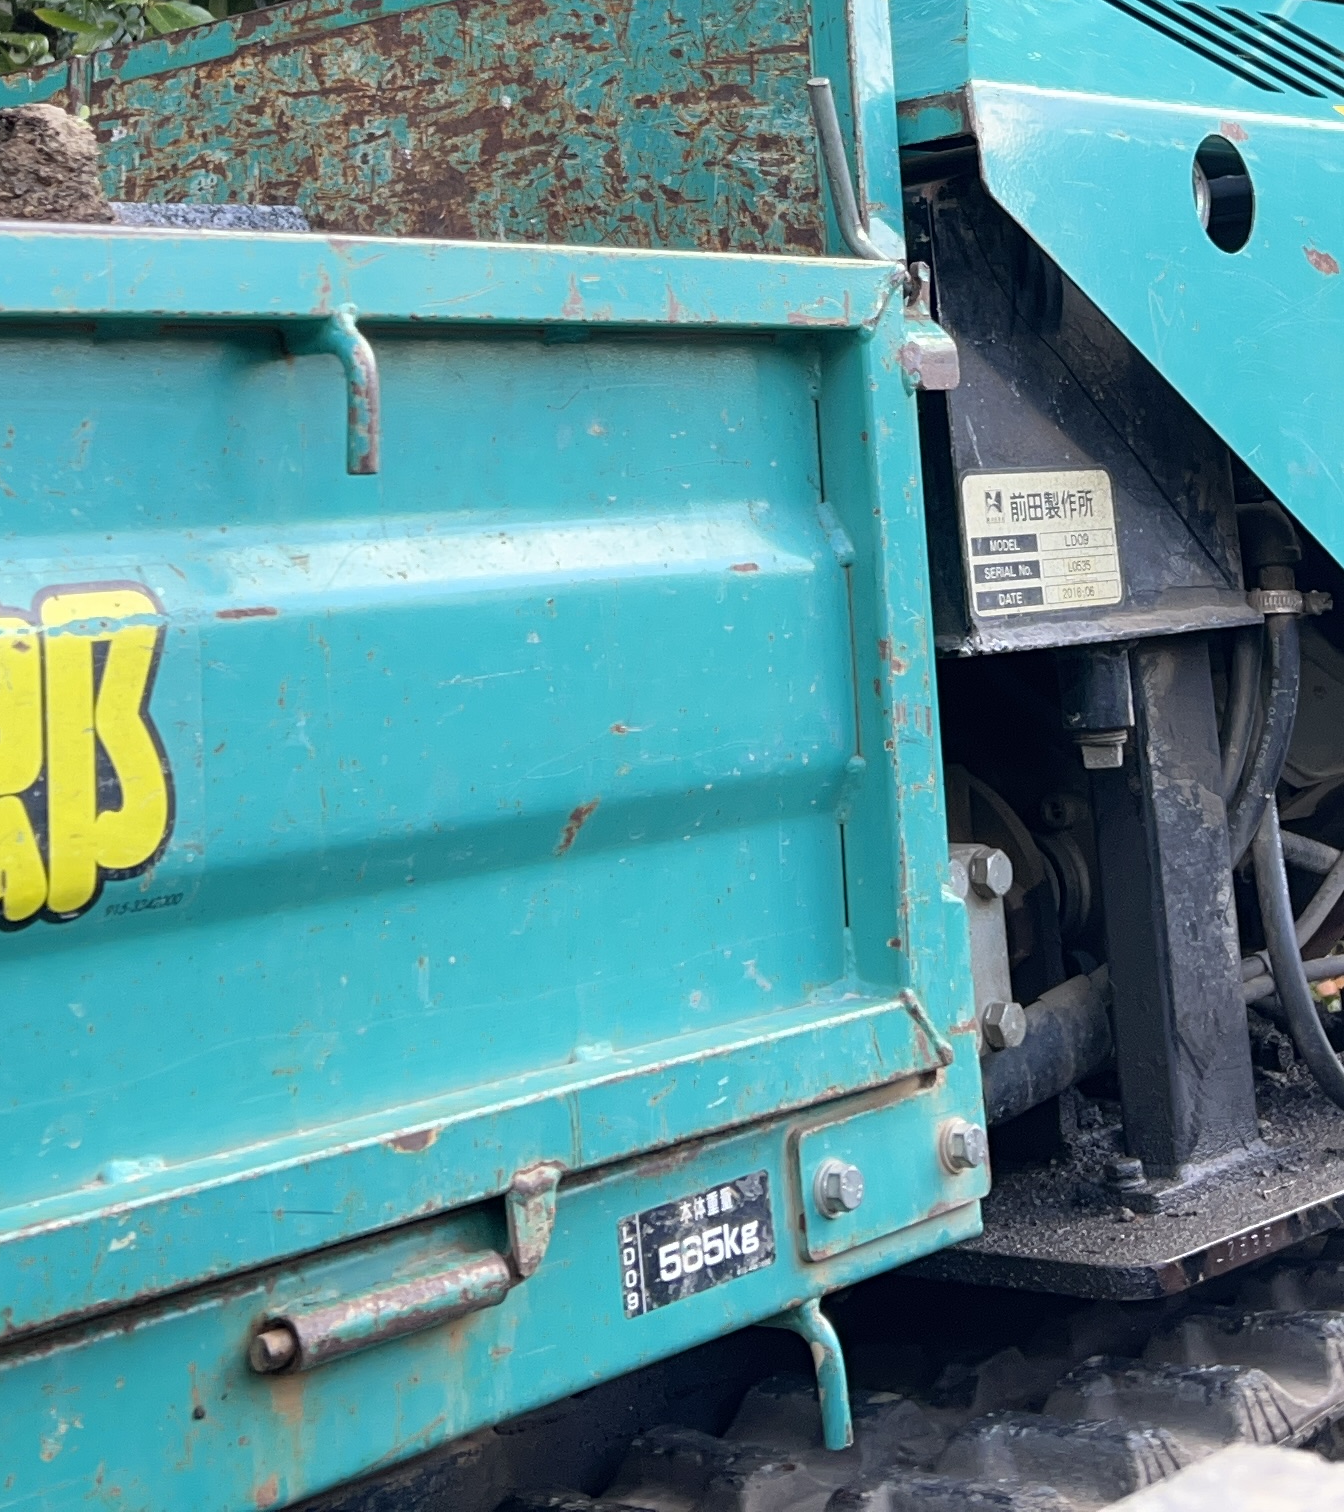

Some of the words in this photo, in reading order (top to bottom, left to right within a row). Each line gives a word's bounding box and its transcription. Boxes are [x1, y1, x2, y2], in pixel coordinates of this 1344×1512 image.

[1009, 490, 1094, 522] 前田製作所
[989, 537, 1021, 552] MODEL
[984, 565, 1017, 580] SERIAL
[1018, 564, 1033, 576] No.
[998, 591, 1023, 606] DATE
